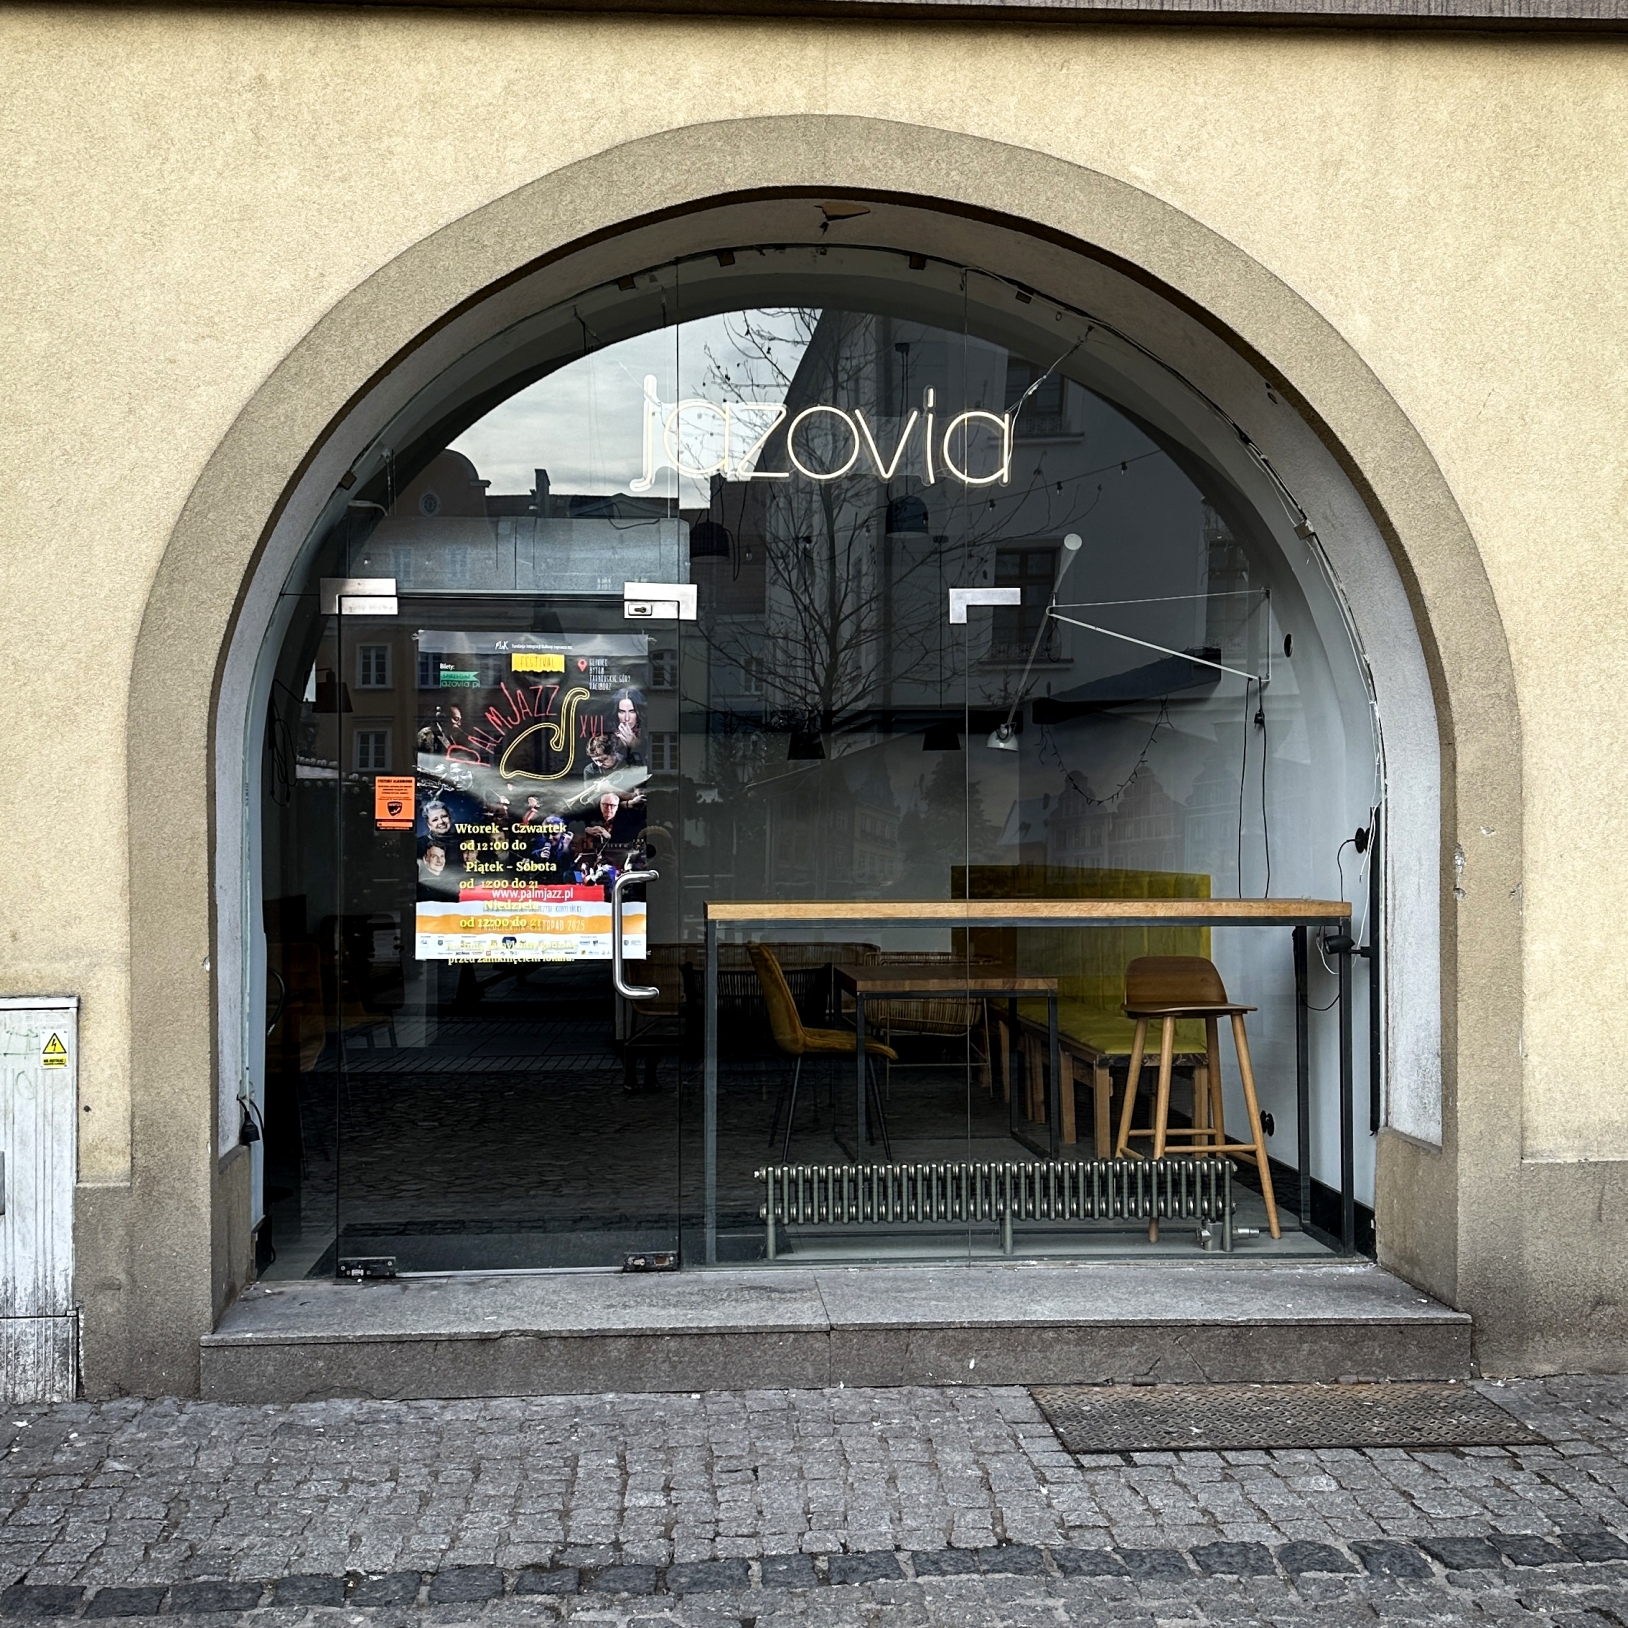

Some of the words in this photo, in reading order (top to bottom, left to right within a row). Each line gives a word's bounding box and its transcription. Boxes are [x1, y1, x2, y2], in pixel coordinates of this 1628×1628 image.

[630, 374, 1010, 492] jazovia
[520, 655, 556, 668] FESTIVAL
[455, 823, 499, 834] Wtorek
[511, 823, 567, 834] Czwartek
[460, 840, 475, 851] od
[511, 840, 527, 851] do
[466, 861, 503, 874] Piątek
[516, 861, 557, 872] Sobota
[460, 878, 474, 889] od
[511, 877, 526, 889] do
[528, 880, 538, 889] 21
[491, 886, 574, 900] www.palmjazz.pl
[484, 899, 540, 911] Niedziela
[460, 916, 475, 928] od
[511, 915, 527, 928] do
[567, 919, 585, 932] 2025
